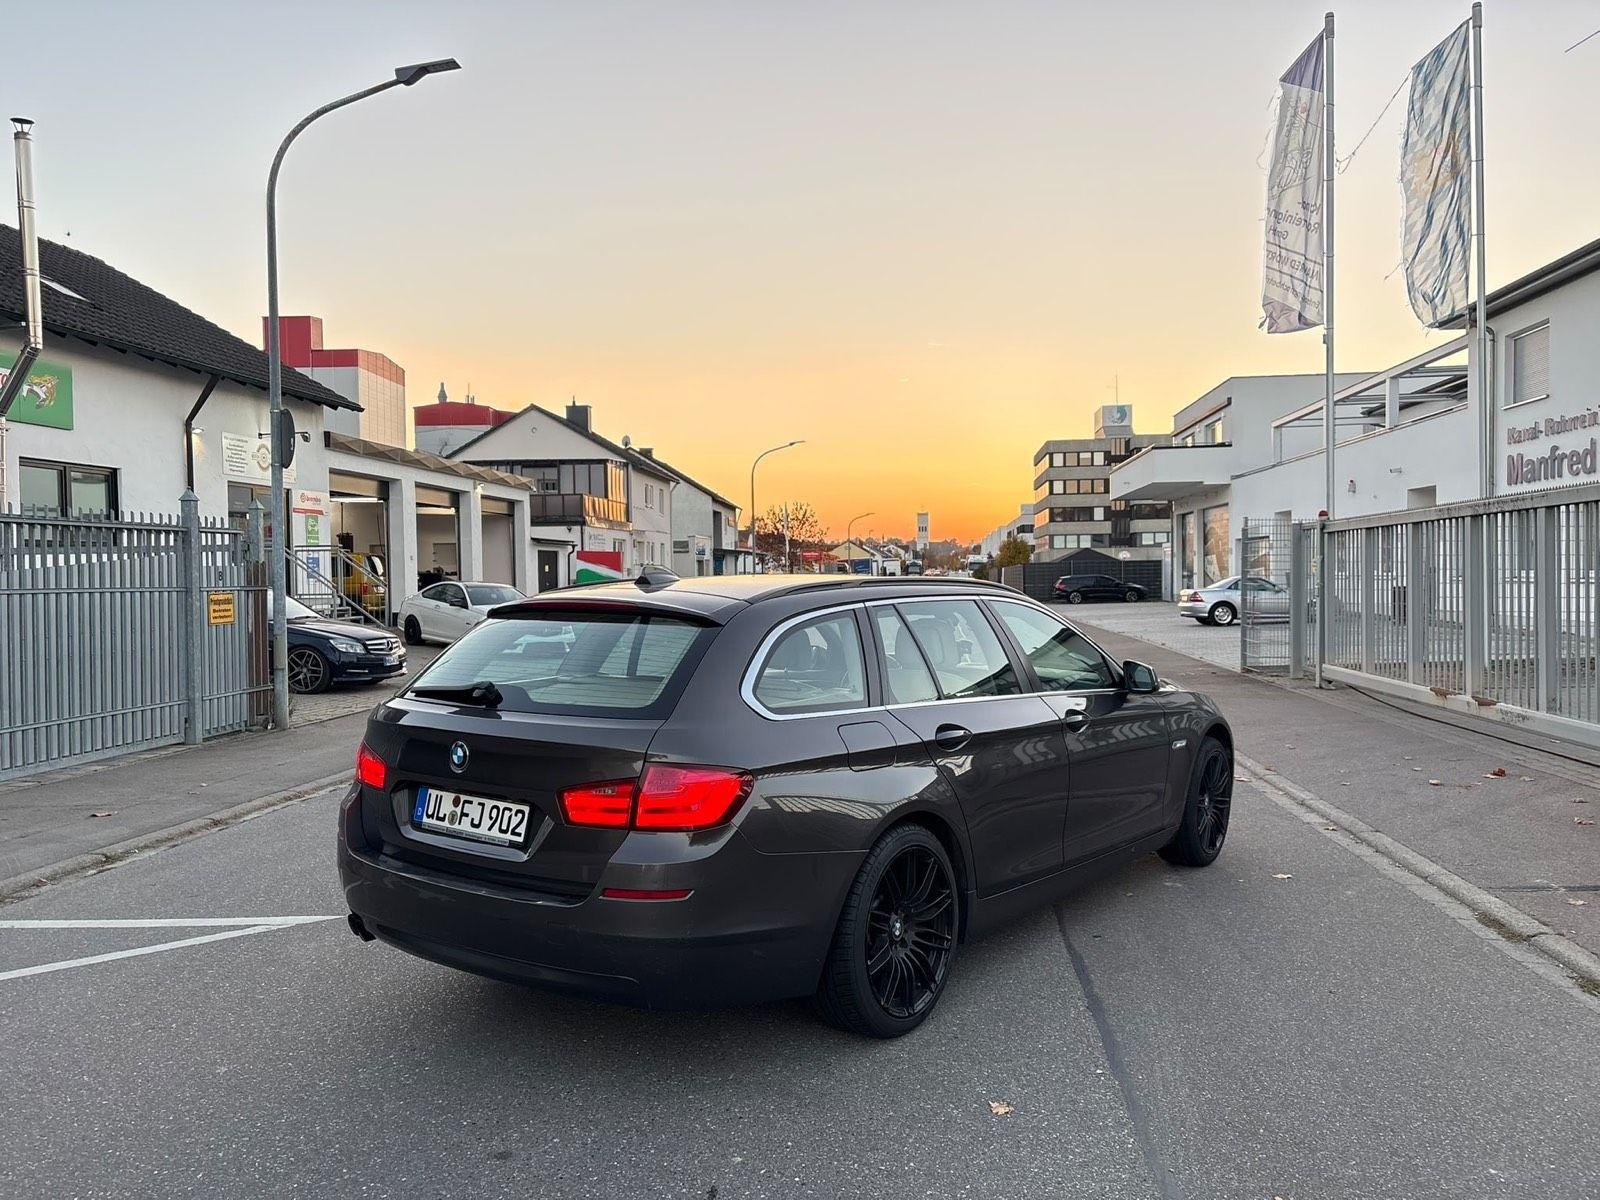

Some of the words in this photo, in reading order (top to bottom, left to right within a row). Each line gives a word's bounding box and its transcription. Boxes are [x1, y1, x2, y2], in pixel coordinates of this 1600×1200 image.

[1506, 437, 1597, 486] Manfred
[426, 793, 446, 822] UL
[458, 800, 486, 829] FJ
[488, 805, 526, 837] 902
